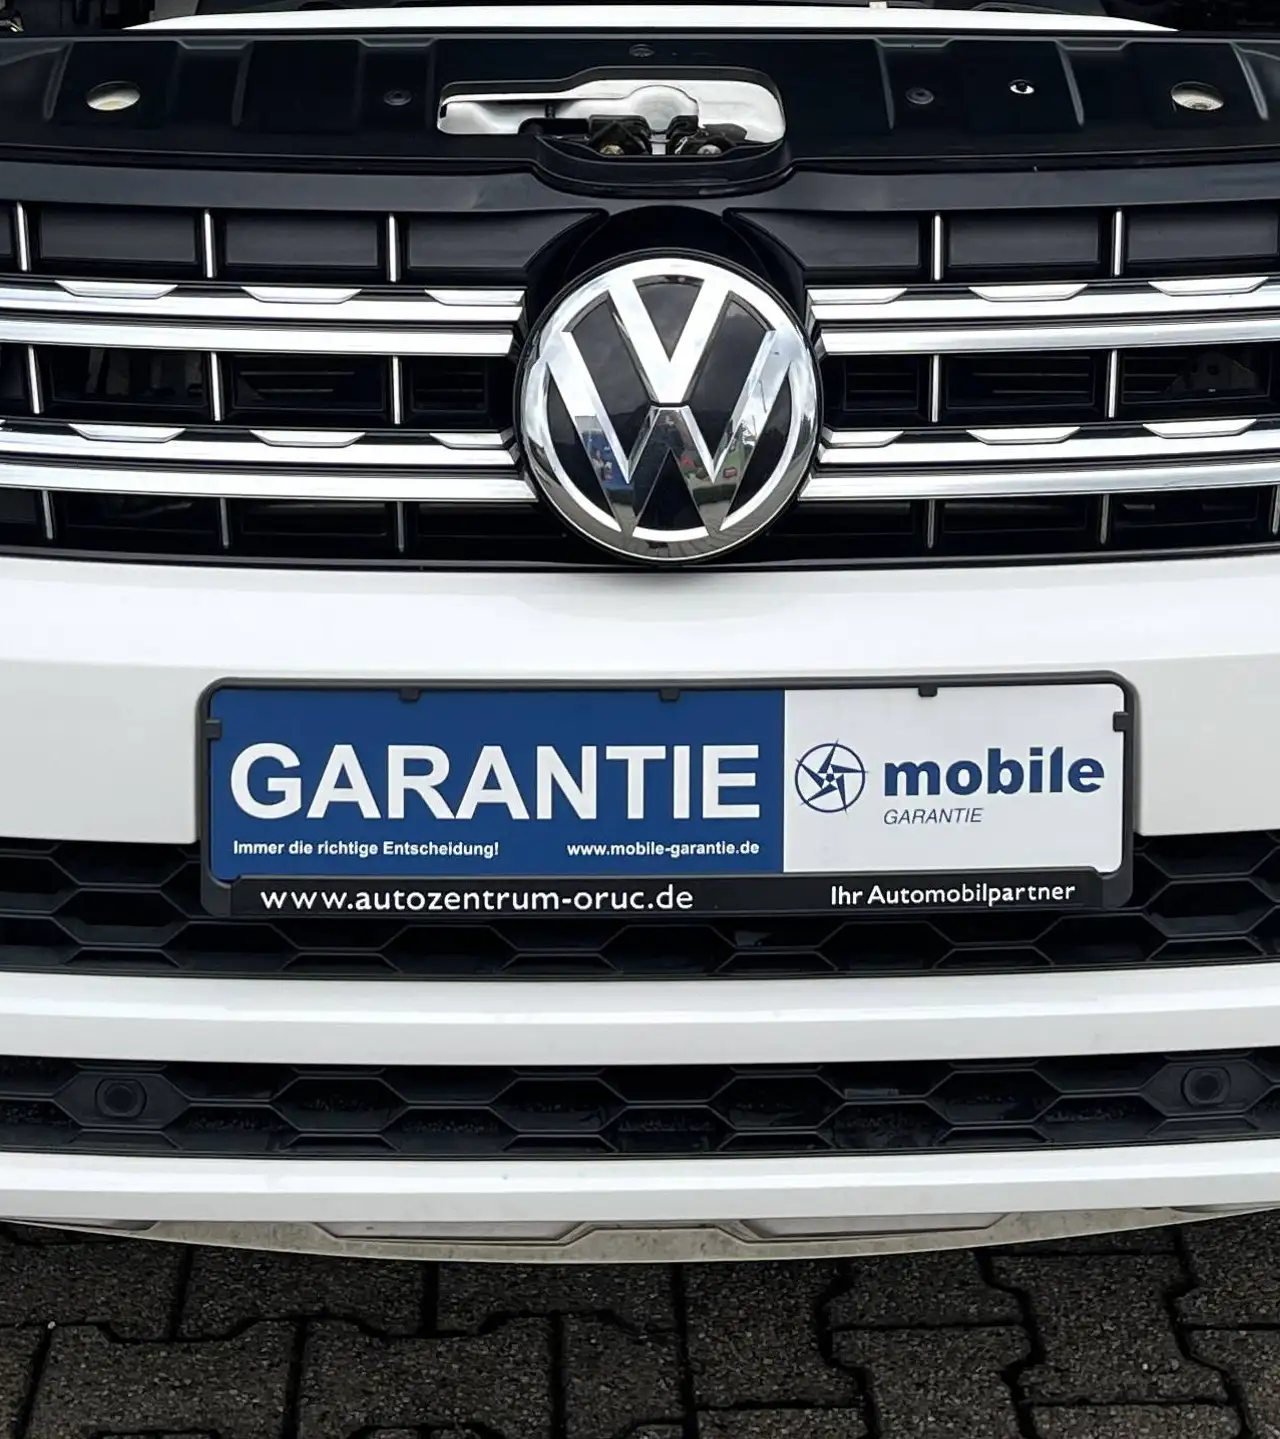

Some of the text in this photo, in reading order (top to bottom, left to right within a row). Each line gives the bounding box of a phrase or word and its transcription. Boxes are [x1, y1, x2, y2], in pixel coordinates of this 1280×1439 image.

[230, 742, 1105, 820] GARANTIE mobile
[883, 806, 985, 825] GARANTIE
[233, 840, 760, 859] Immer die richtige Entscheidung! www.mobile-garantie.de
[260, 882, 1076, 911] www.autozentrum-oruc.de Ihr Automobilpartner
